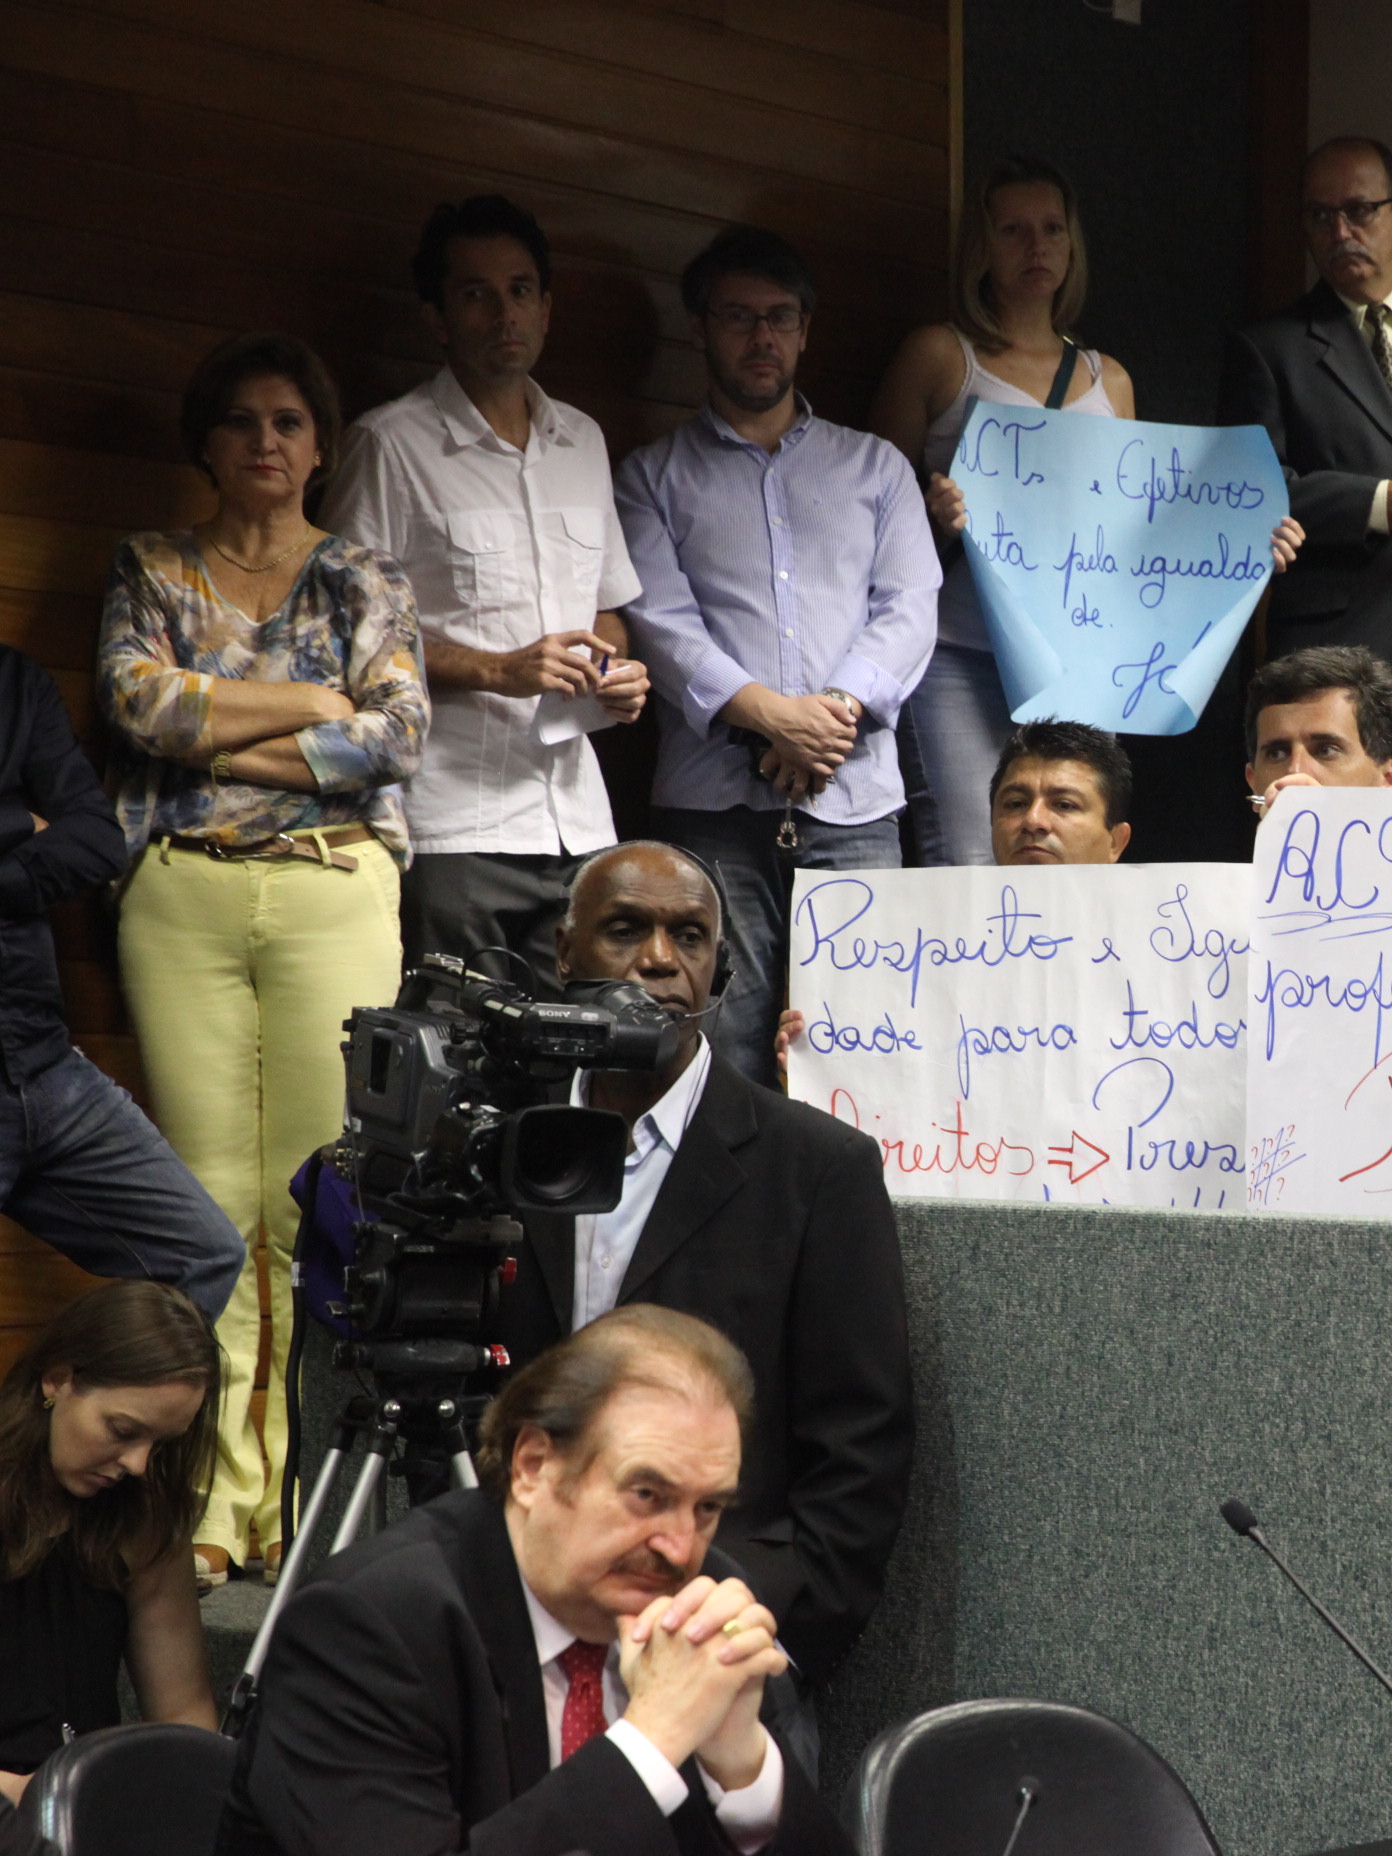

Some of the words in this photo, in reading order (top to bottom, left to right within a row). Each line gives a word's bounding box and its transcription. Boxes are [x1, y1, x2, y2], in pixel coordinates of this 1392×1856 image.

[1089, 478, 1102, 495] e
[1116, 439, 1264, 523] Efetivos
[1054, 524, 1118, 609] pela
[795, 878, 1075, 1009] Respeito
[1091, 937, 1121, 964] e
[538, 1009, 571, 1018] SONY
[808, 1001, 924, 1054] dade
[957, 1014, 1078, 1100] para
